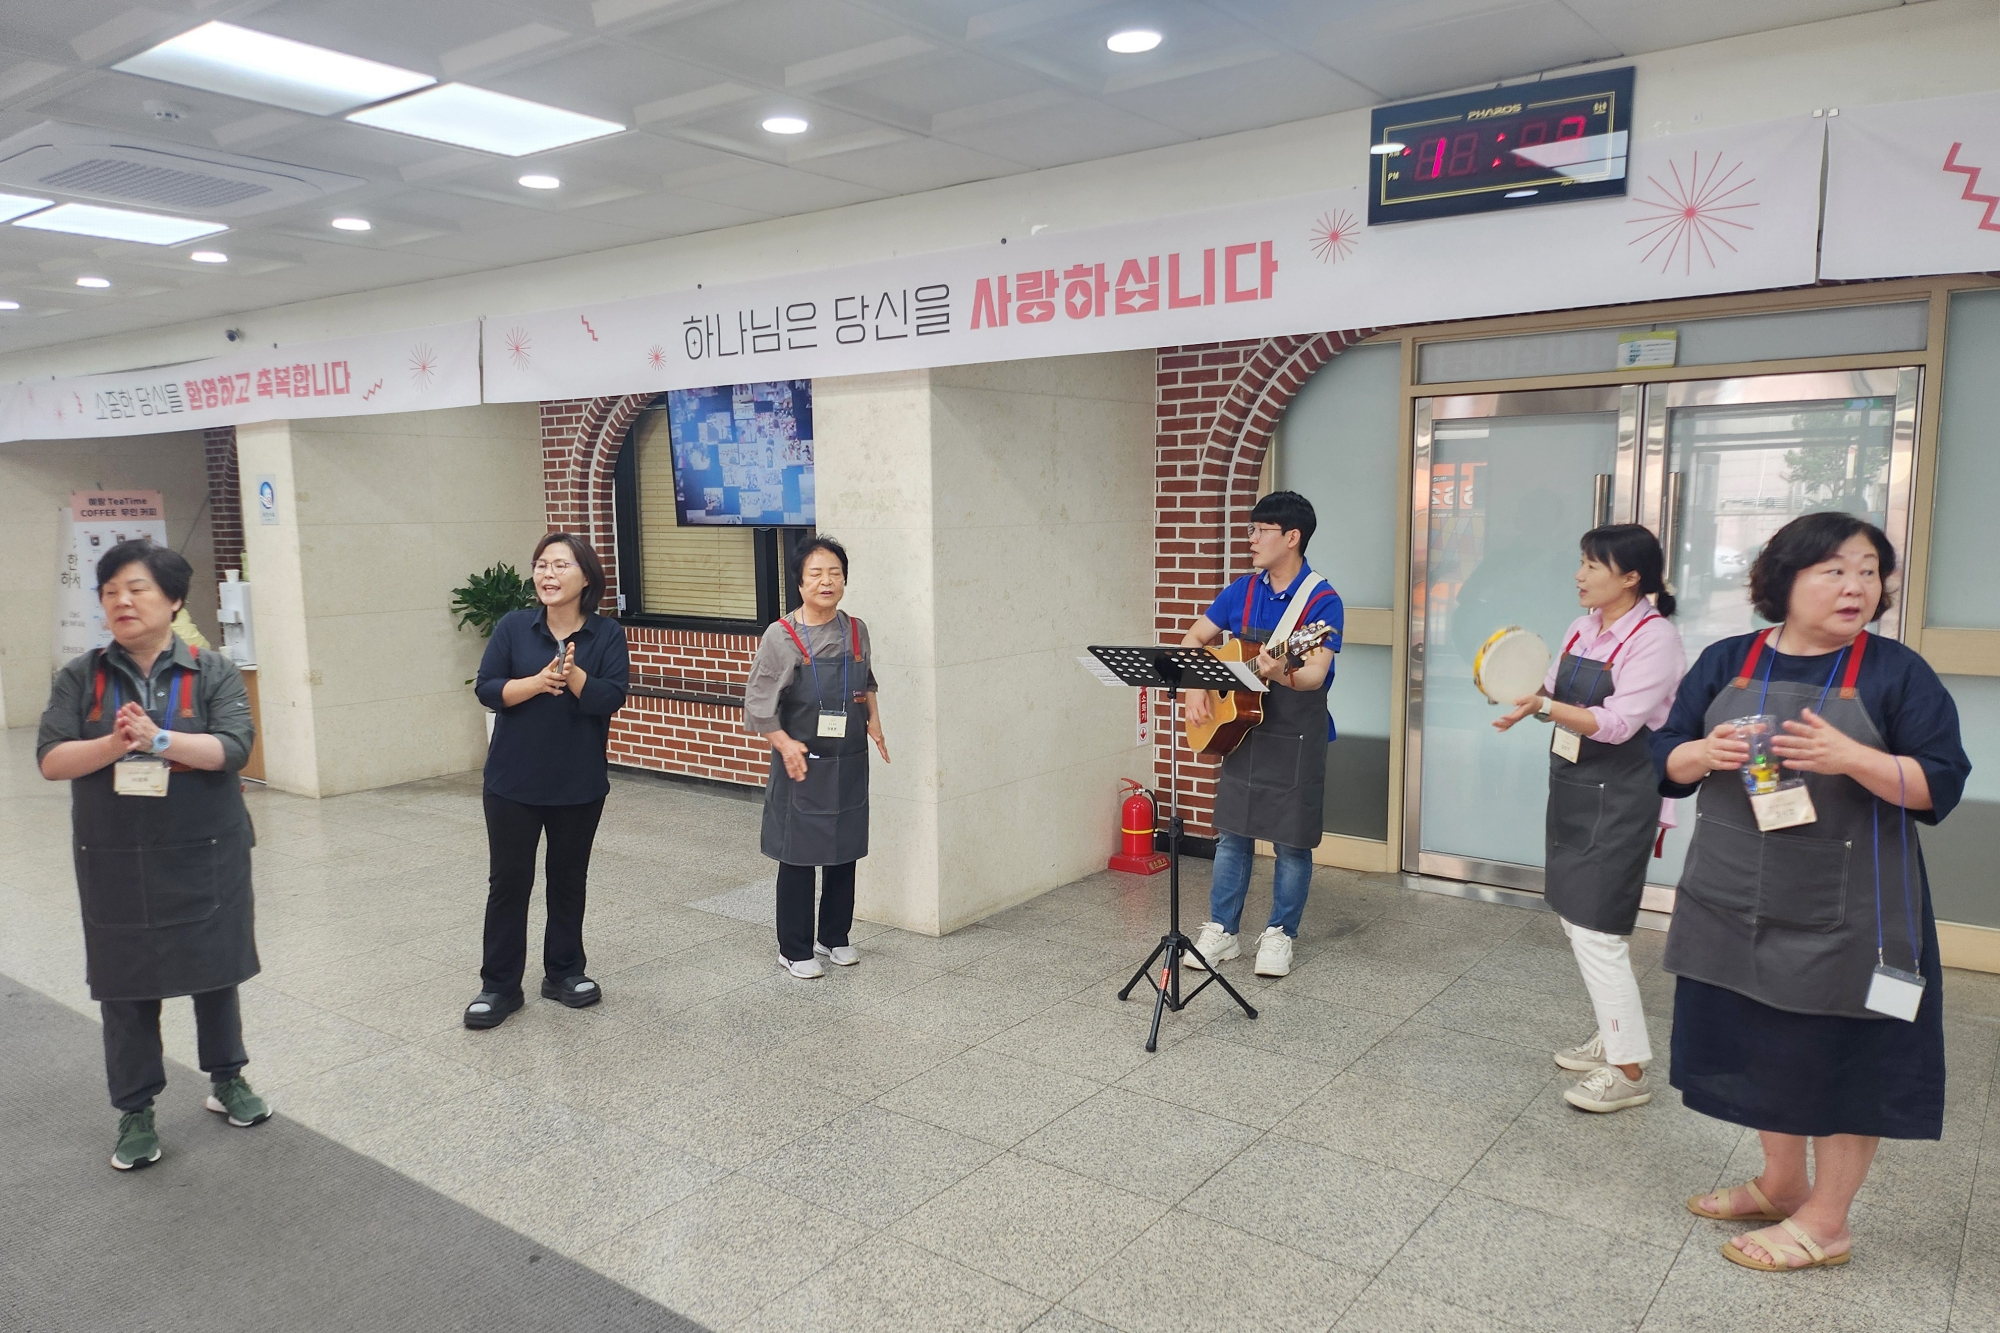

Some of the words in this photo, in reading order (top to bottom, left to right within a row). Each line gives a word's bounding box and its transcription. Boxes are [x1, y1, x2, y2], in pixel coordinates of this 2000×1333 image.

[1467, 103, 1523, 120] PHAROS
[1387, 171, 1400, 181] PM
[683, 302, 818, 360] 하나님은
[834, 283, 951, 345] 당신을
[969, 240, 1279, 331] 사랑하십니다
[96, 388, 136, 420] 소중한
[136, 383, 184, 416] 당신을
[184, 372, 251, 412] 환영하고
[256, 361, 352, 399] 축복합니다
[108, 497, 148, 506] TeaTime
[81, 509, 118, 517] COFFEE
[140, 507, 157, 516] 커피
